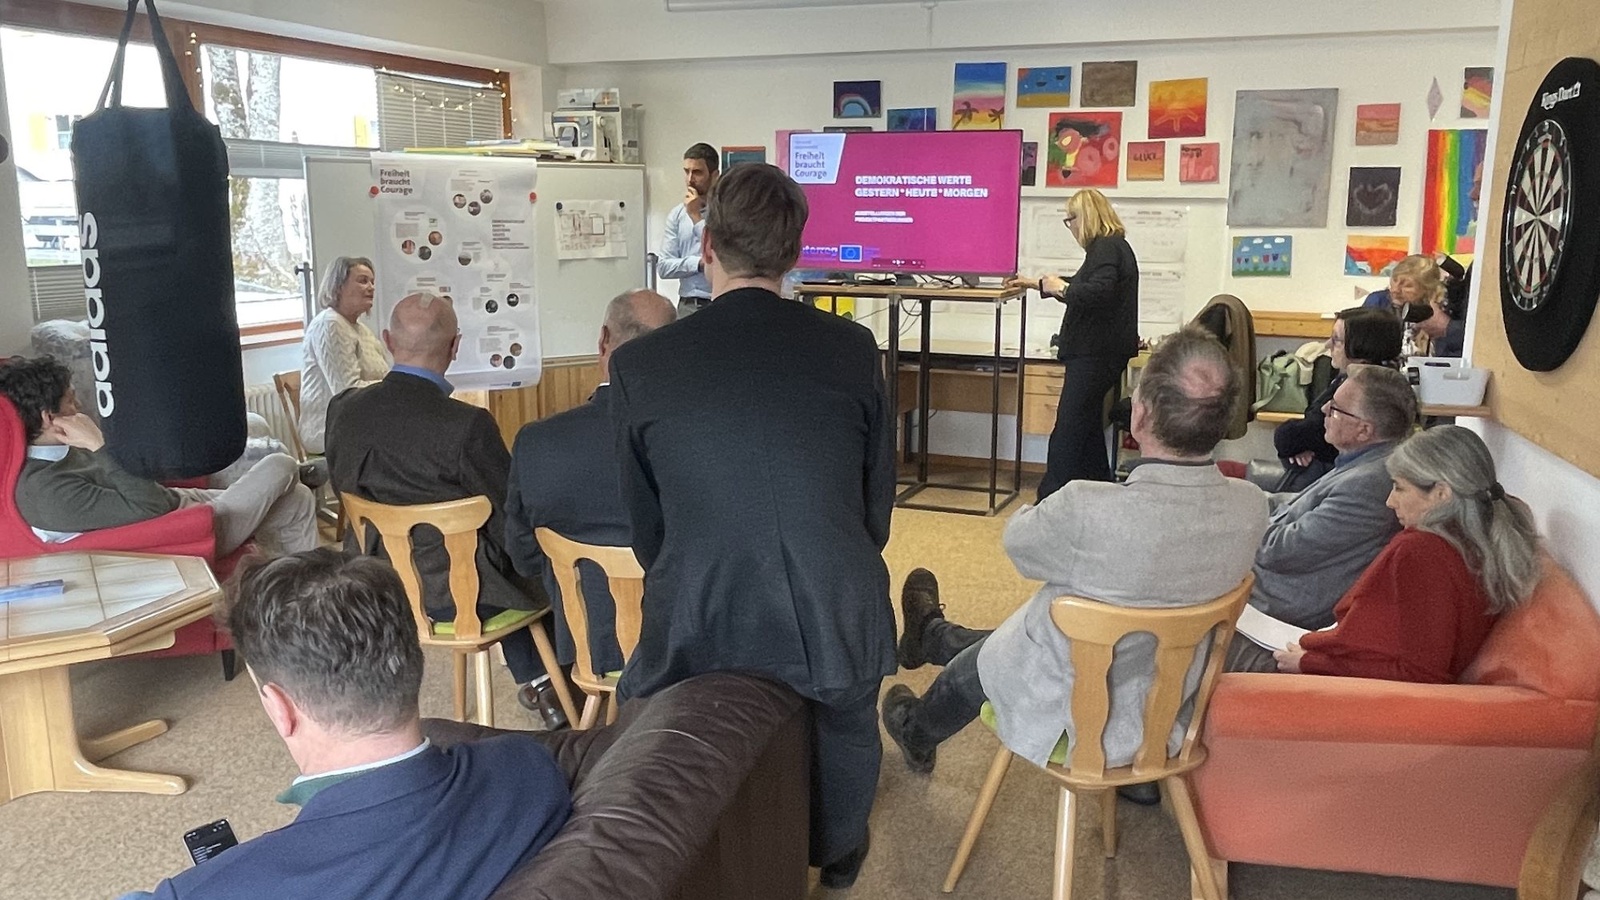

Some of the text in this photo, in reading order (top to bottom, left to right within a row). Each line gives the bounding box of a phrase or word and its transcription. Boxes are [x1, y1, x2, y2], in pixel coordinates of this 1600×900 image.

[794, 151, 825, 160] Freiheit
[794, 160, 825, 169] braucht
[380, 169, 410, 178] Freiheit
[794, 169, 828, 180] Courage
[380, 178, 411, 186] braucht
[855, 175, 972, 185] DEMOKRATISCHE WERTE
[380, 185, 413, 196] Courage
[854, 187, 988, 198] GESTERN HEUTE MORGEN
[79, 211, 115, 418] adidas
